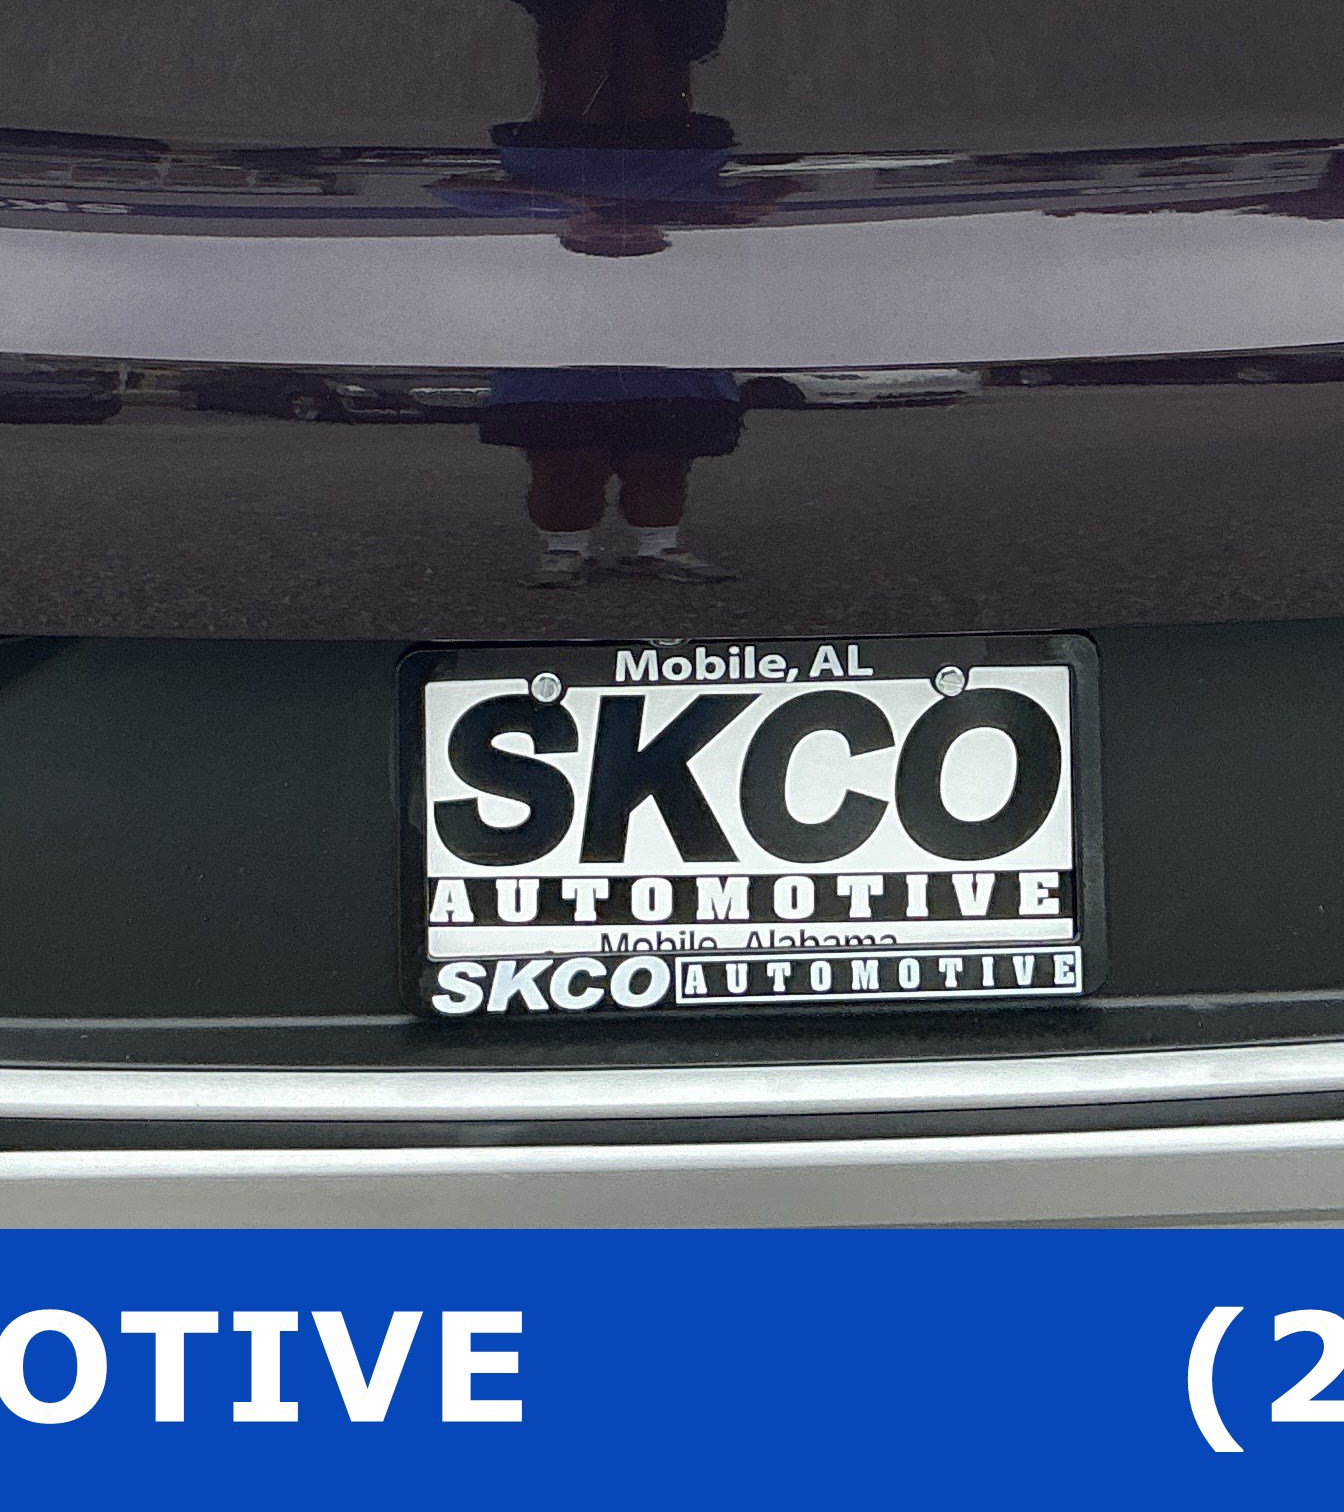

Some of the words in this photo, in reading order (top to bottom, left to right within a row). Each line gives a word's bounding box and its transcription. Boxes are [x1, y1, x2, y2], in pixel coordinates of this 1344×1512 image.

[615, 646, 800, 683] Mobile,
[809, 644, 874, 678] AL
[433, 687, 1062, 867] SKCO
[430, 871, 1059, 923] AUTOMOTIVE
[432, 956, 671, 1015] SKCO
[683, 953, 1077, 996] AUTOMOTIVE
